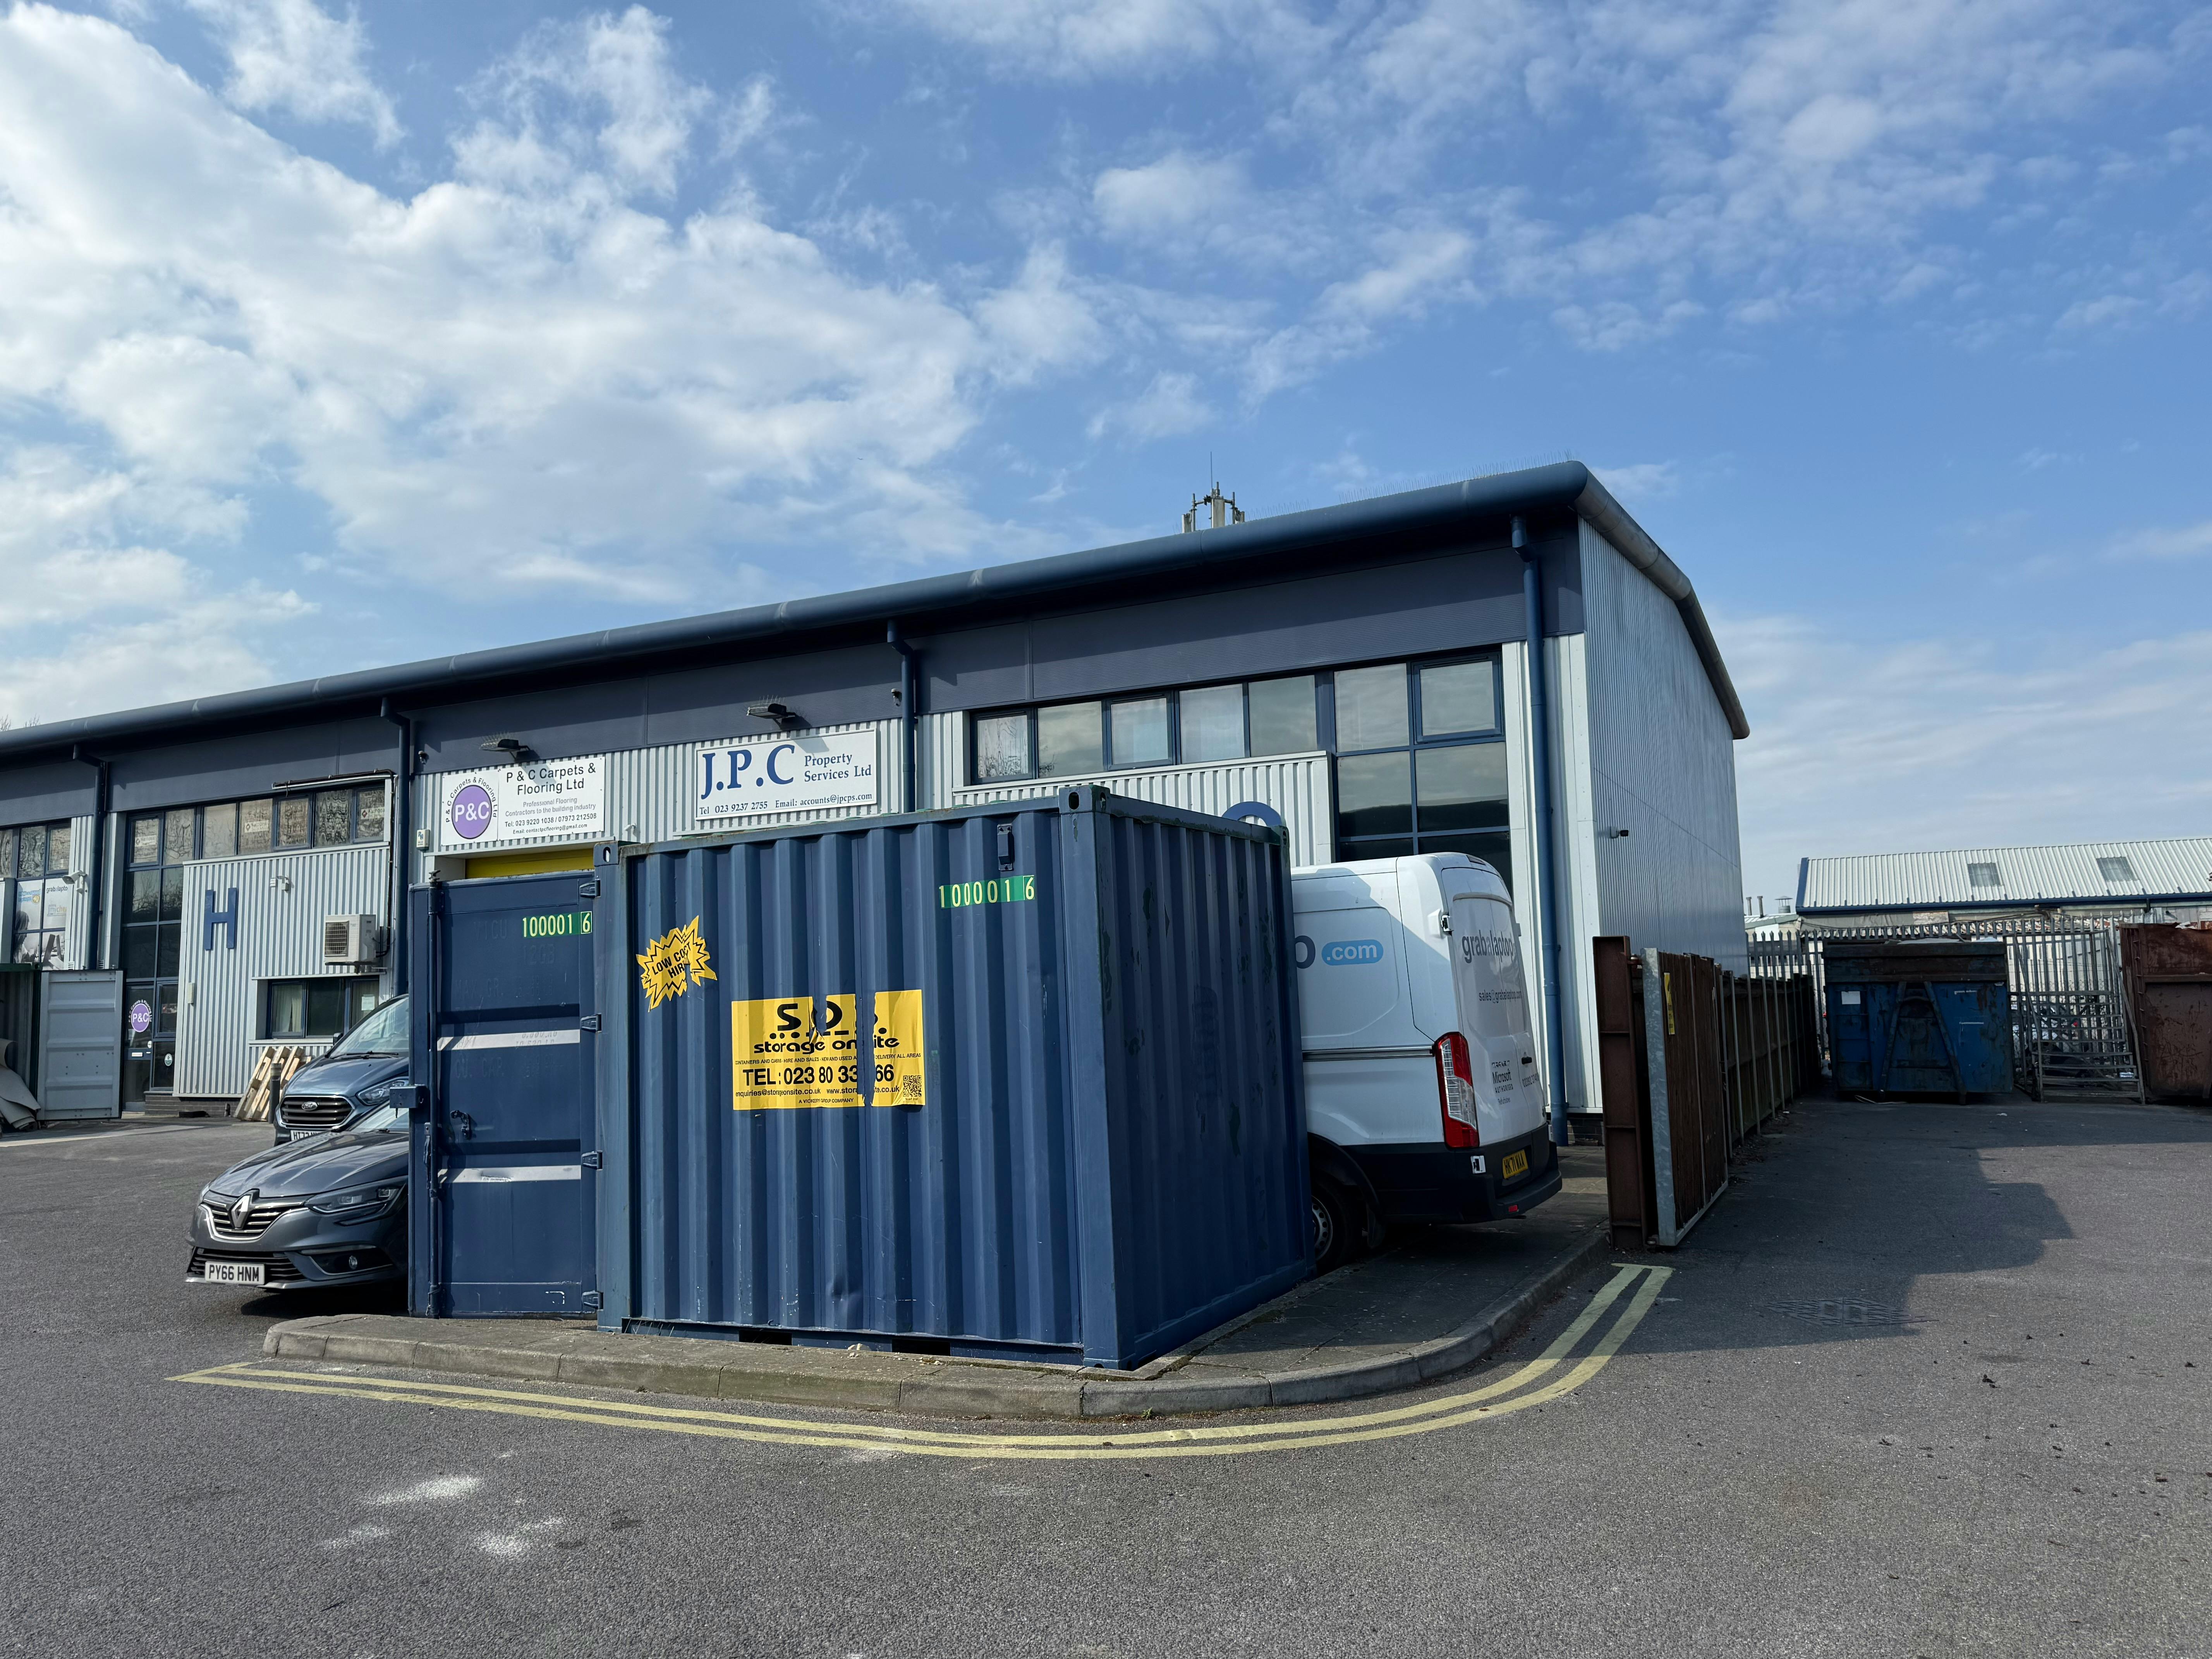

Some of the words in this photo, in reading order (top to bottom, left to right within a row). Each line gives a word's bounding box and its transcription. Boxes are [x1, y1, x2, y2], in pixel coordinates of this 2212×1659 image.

[804, 753, 852, 768] Property
[507, 772, 513, 783] P
[517, 771, 524, 781] &
[528, 769, 536, 780] C
[539, 765, 584, 780] Carpets
[588, 763, 596, 773] &
[804, 769, 849, 782] Services
[854, 764, 872, 777] Ltd
[450, 779, 471, 799] Carpets
[478, 778, 496, 802] Flooring
[517, 781, 562, 795] Flooring
[567, 778, 584, 790] Ltd
[455, 801, 489, 822] P&C
[523, 799, 555, 807] Professional
[715, 805, 728, 813] 023
[731, 803, 748, 812] 9237
[751, 801, 768, 810] 2755
[775, 799, 797, 808] Email:
[800, 794, 872, 804] accounts@jpcps.com
[939, 879, 1010, 908] 100001
[203, 887, 237, 950] H
[522, 914, 572, 938] 100001
[1327, 945, 1377, 960] .com
[652, 956, 672, 975] LOW
[668, 962, 685, 979] HIR
[132, 1012, 148, 1023] P&C
[754, 1041, 826, 1054] storage
[783, 1066, 815, 1085] 023
[819, 1066, 833, 1084] 80
[1492, 1068, 1511, 1084] Microsoft
[209, 1264, 234, 1280] PY66
[237, 1266, 259, 1282] HNM
